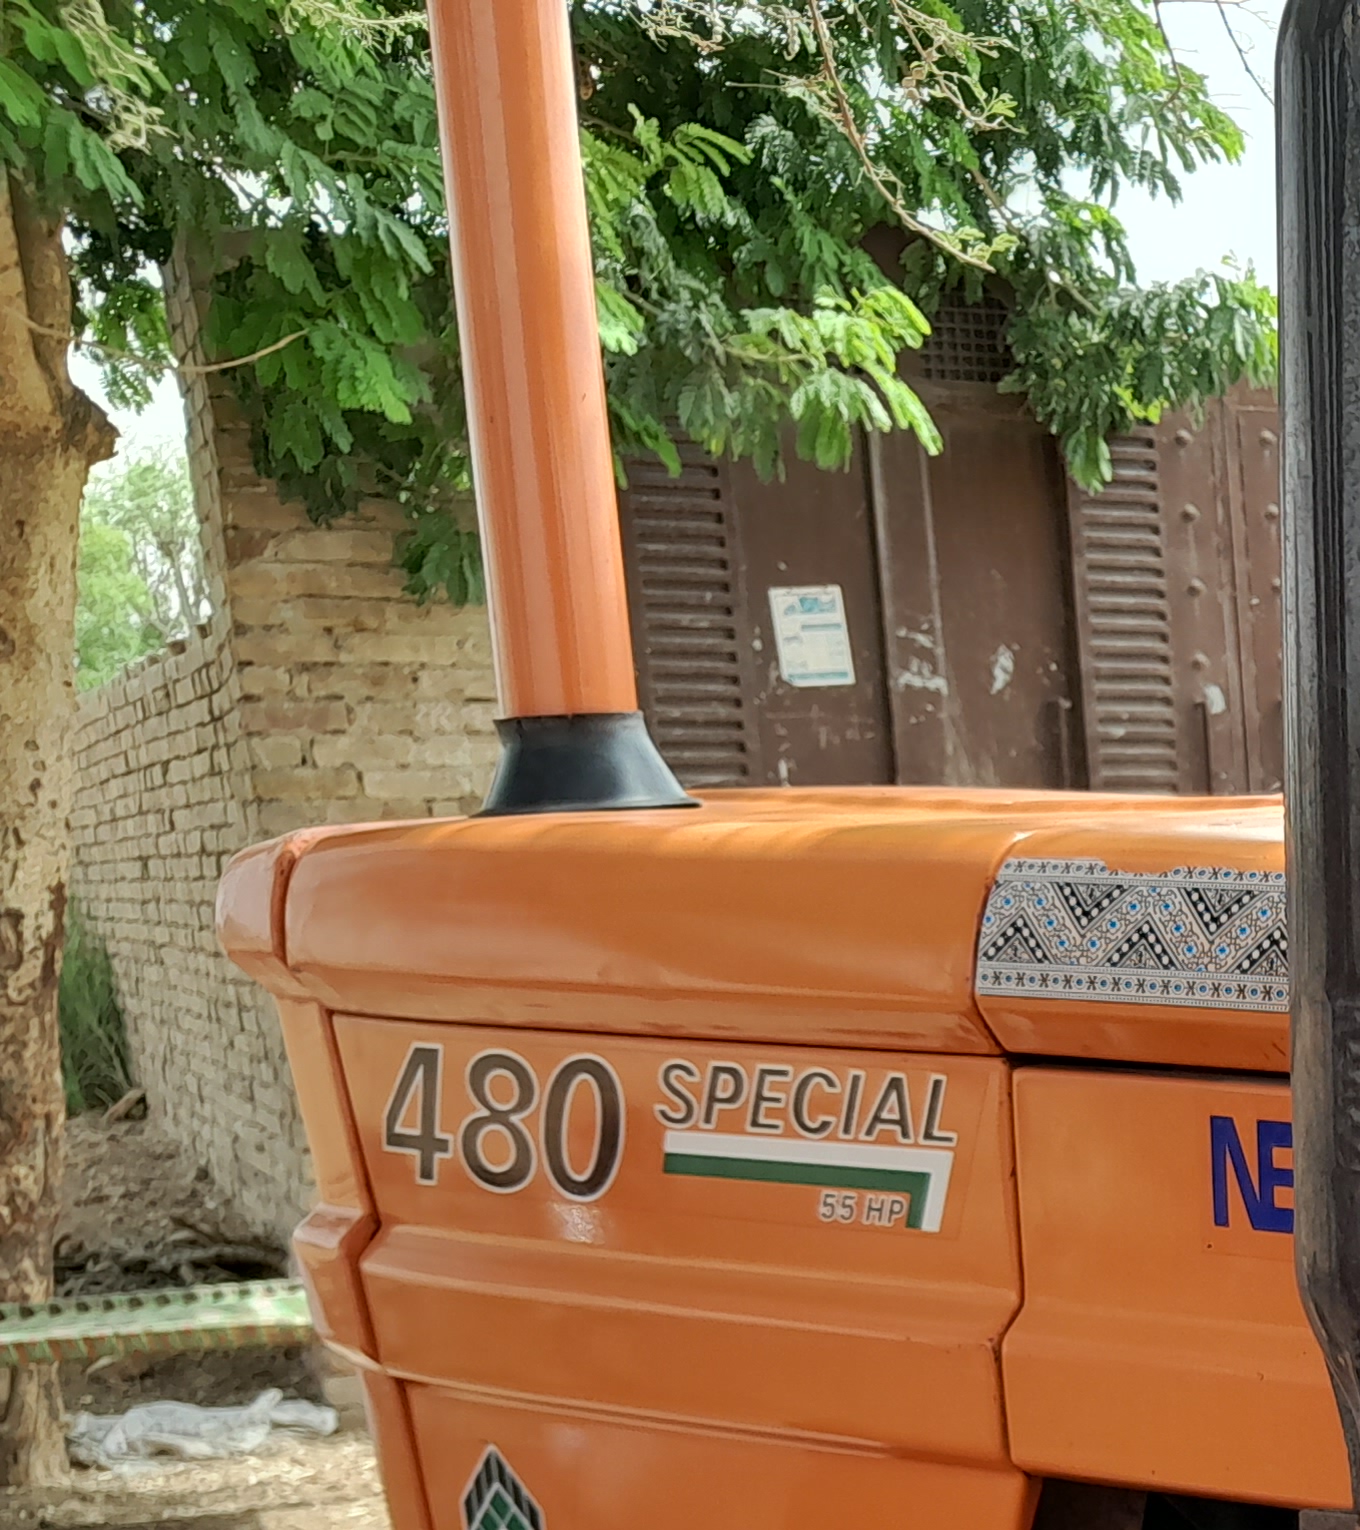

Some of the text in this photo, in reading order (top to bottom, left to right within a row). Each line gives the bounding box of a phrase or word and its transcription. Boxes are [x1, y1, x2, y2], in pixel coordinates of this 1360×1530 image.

[384, 1044, 623, 1200] 480
[656, 1060, 956, 1144] SPECIAL
[820, 1192, 905, 1224] 55 HP
[1208, 1114, 1294, 1235] NE
